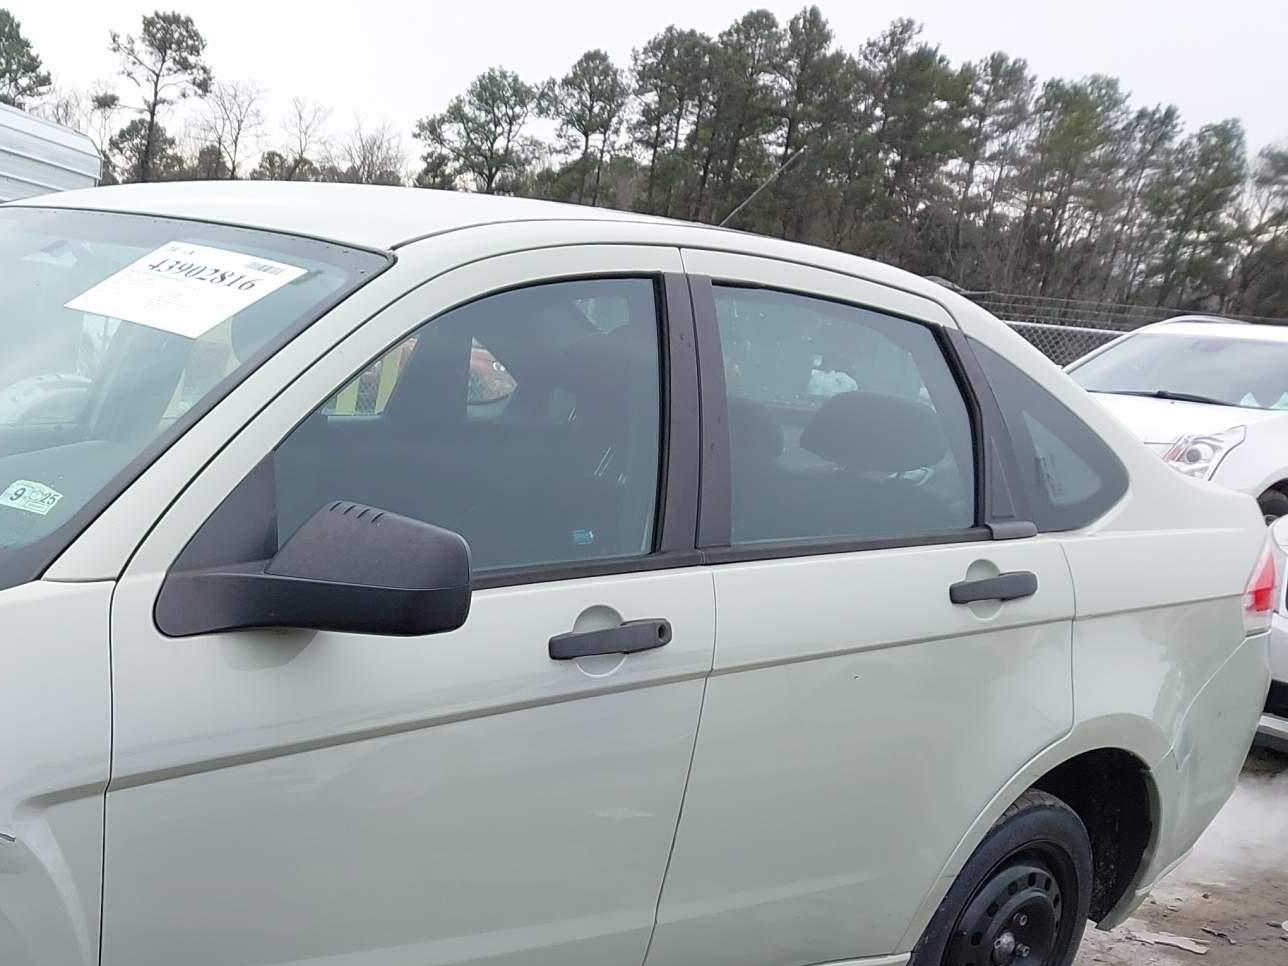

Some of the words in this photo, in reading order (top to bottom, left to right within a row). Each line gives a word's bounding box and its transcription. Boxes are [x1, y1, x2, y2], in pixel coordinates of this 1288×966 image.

[148, 258, 262, 291] 43902816
[10, 487, 27, 501] 9
[40, 492, 59, 505] 25
